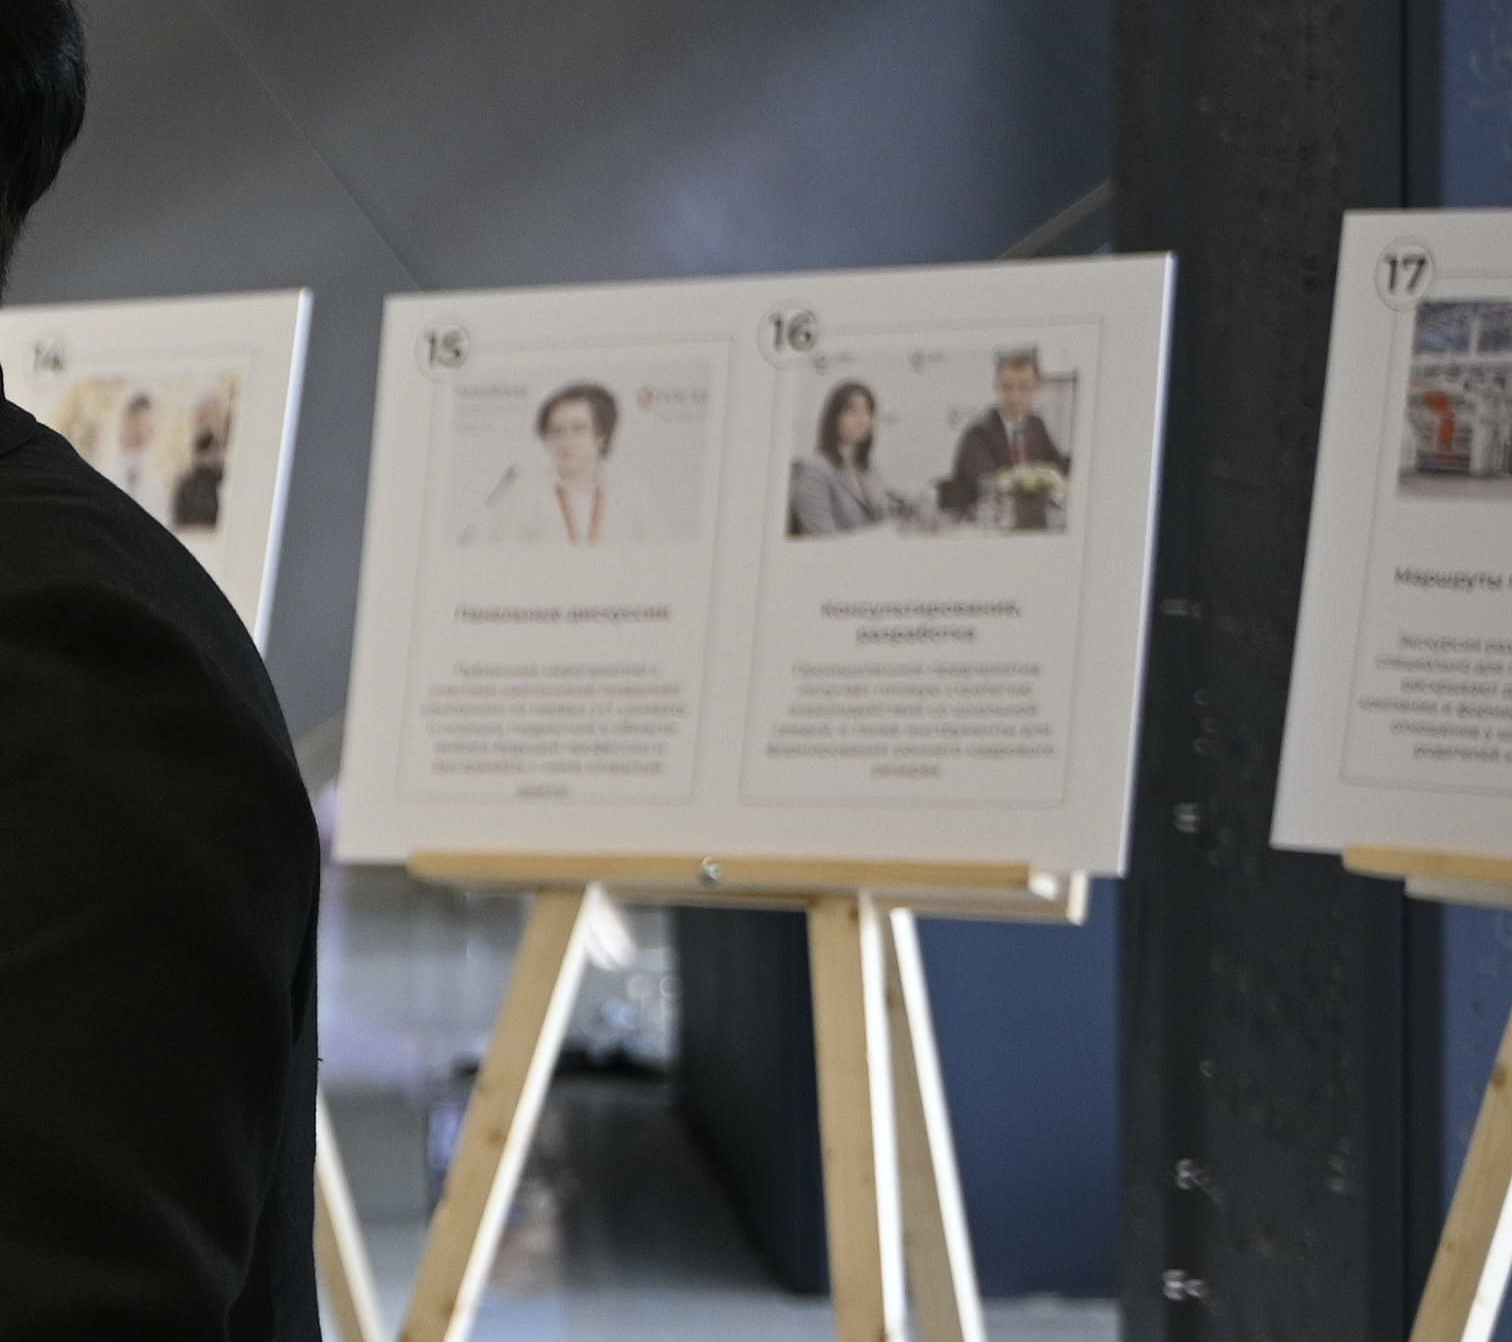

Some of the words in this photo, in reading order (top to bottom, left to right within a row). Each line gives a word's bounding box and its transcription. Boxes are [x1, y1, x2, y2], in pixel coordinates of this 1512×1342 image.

[1383, 252, 1427, 296] 17
[424, 327, 465, 370] 15
[767, 311, 816, 354] 16
